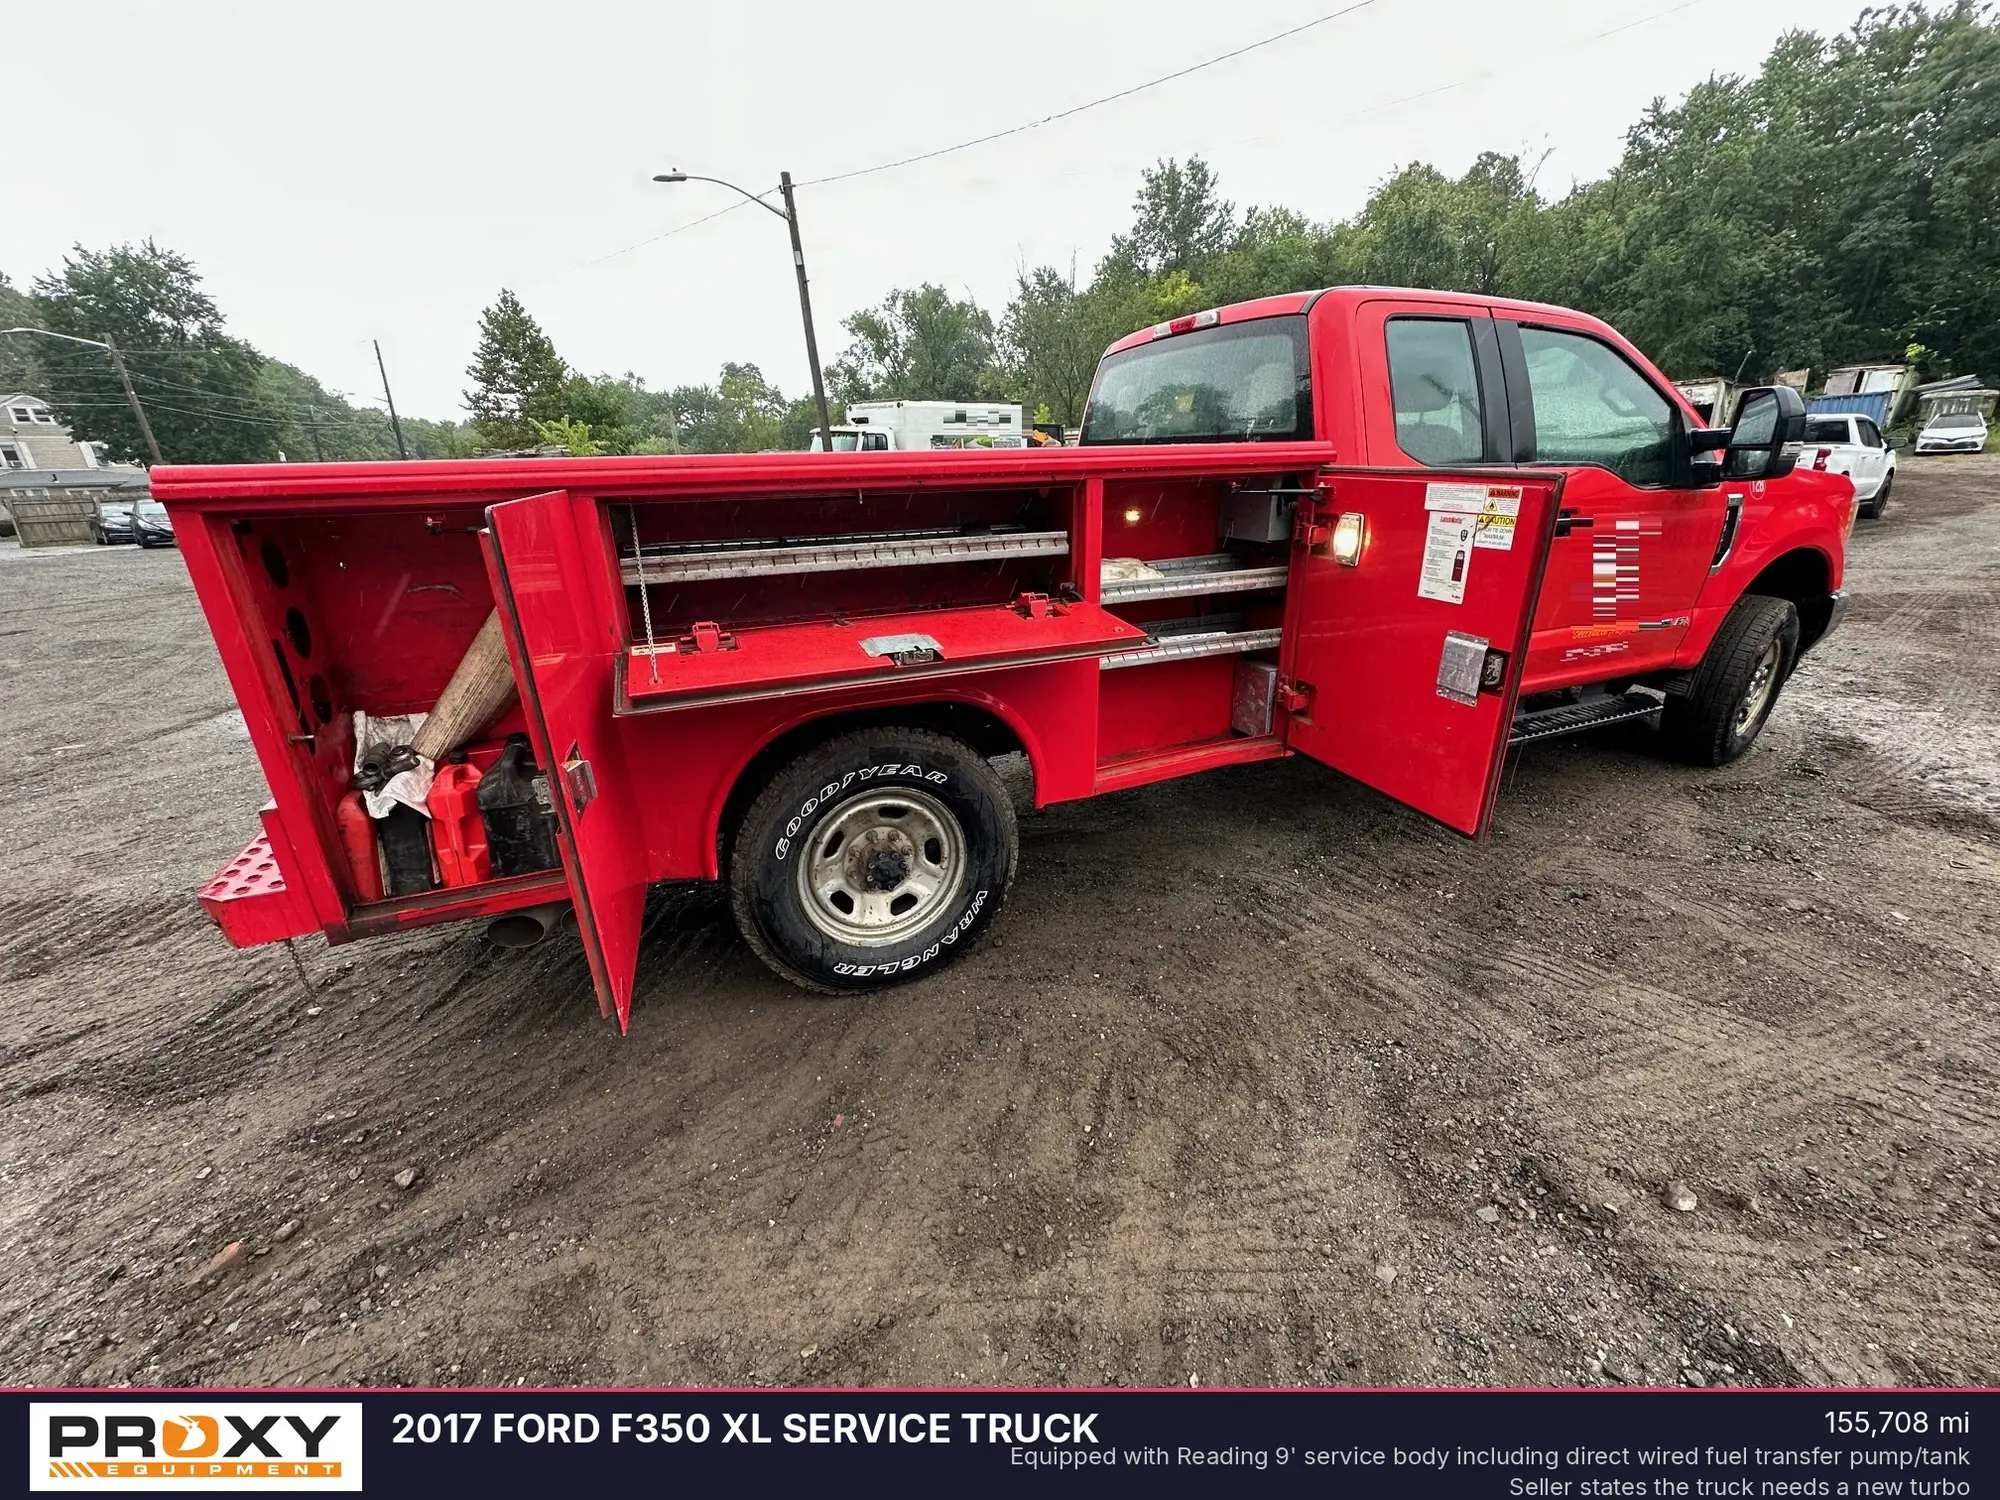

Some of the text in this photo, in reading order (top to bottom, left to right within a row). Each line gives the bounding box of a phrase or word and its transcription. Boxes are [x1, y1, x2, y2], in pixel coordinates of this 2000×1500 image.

[1497, 489, 1519, 498] WARNING
[775, 764, 948, 860] GOODYEAR
[833, 890, 988, 976] WRANGLER
